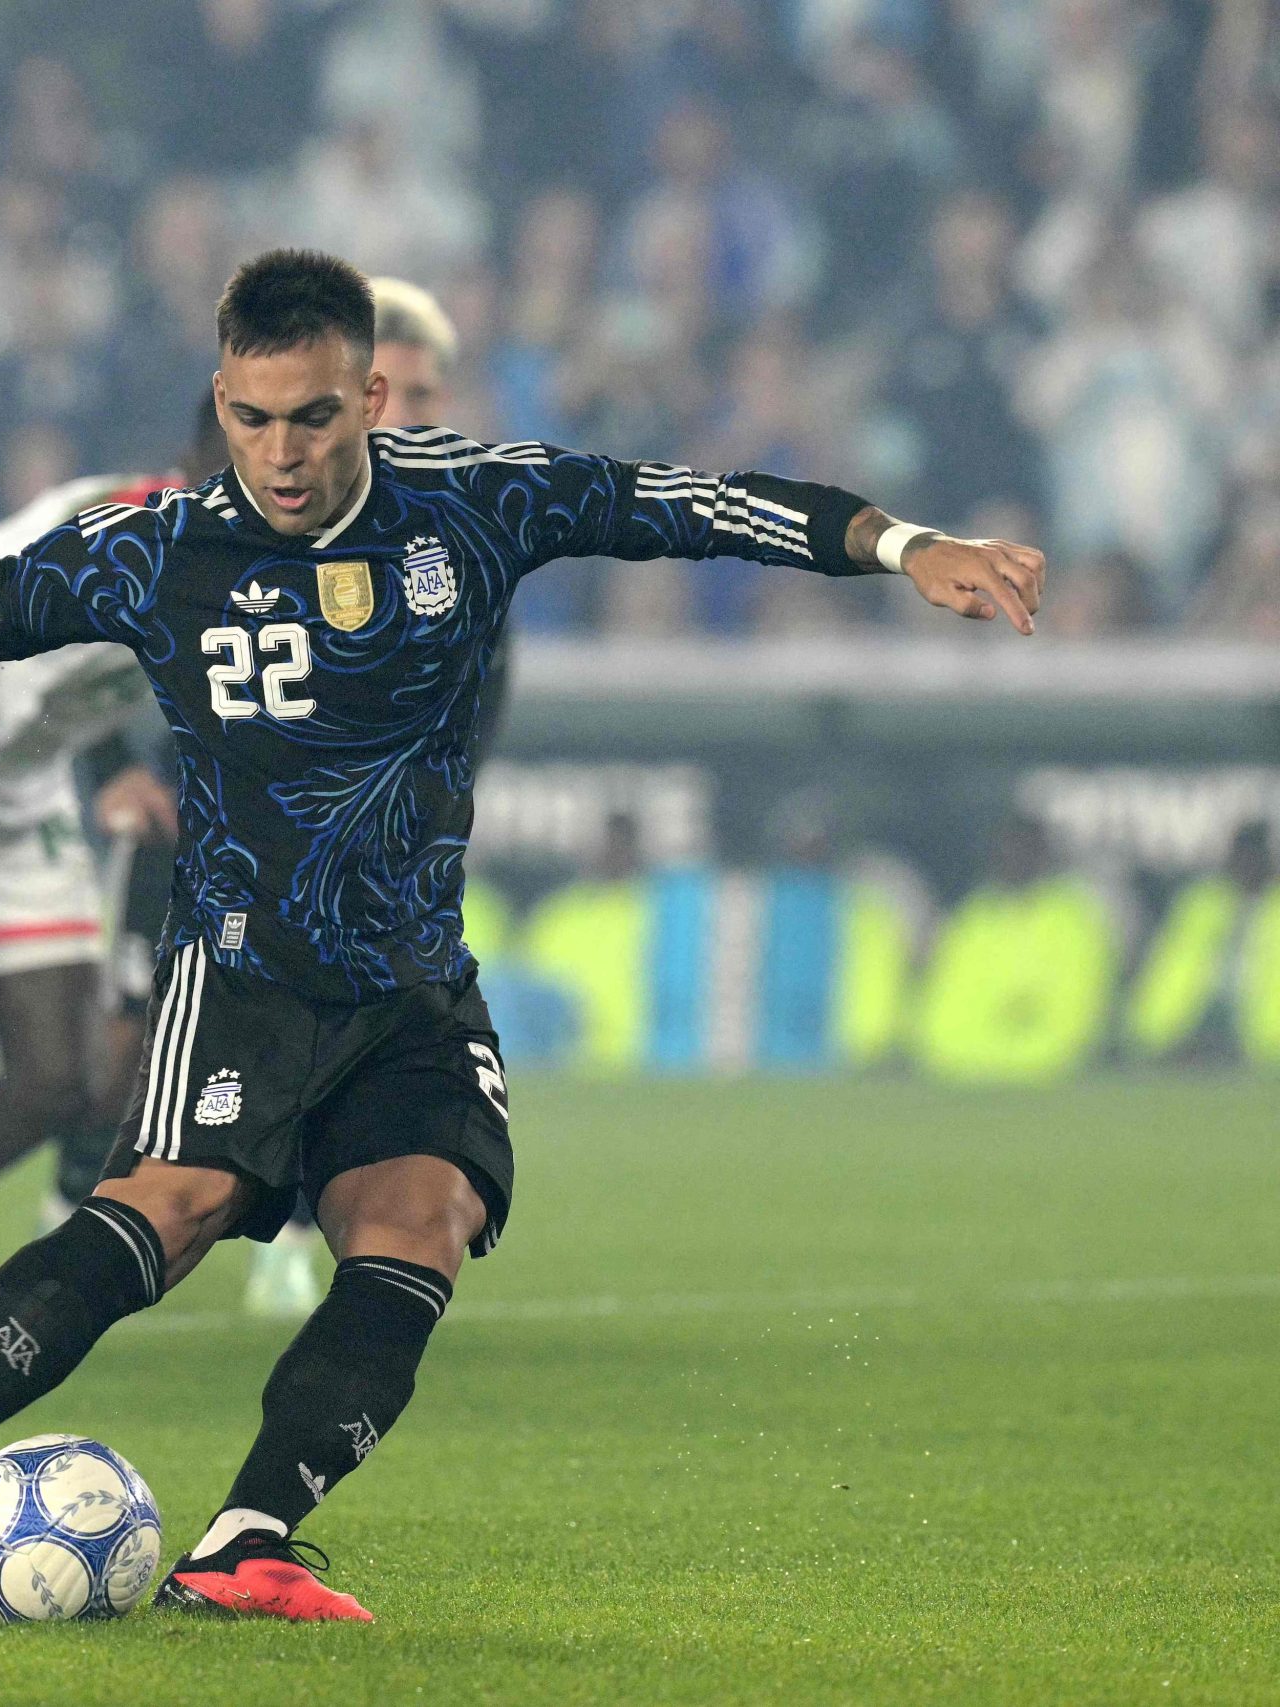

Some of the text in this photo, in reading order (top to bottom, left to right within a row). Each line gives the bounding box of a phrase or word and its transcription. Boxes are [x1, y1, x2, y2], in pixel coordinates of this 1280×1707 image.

[417, 565, 446, 595] AFA
[201, 623, 317, 720] 22
[205, 1093, 231, 1112] AFA
[467, 1041, 509, 1123] 2
